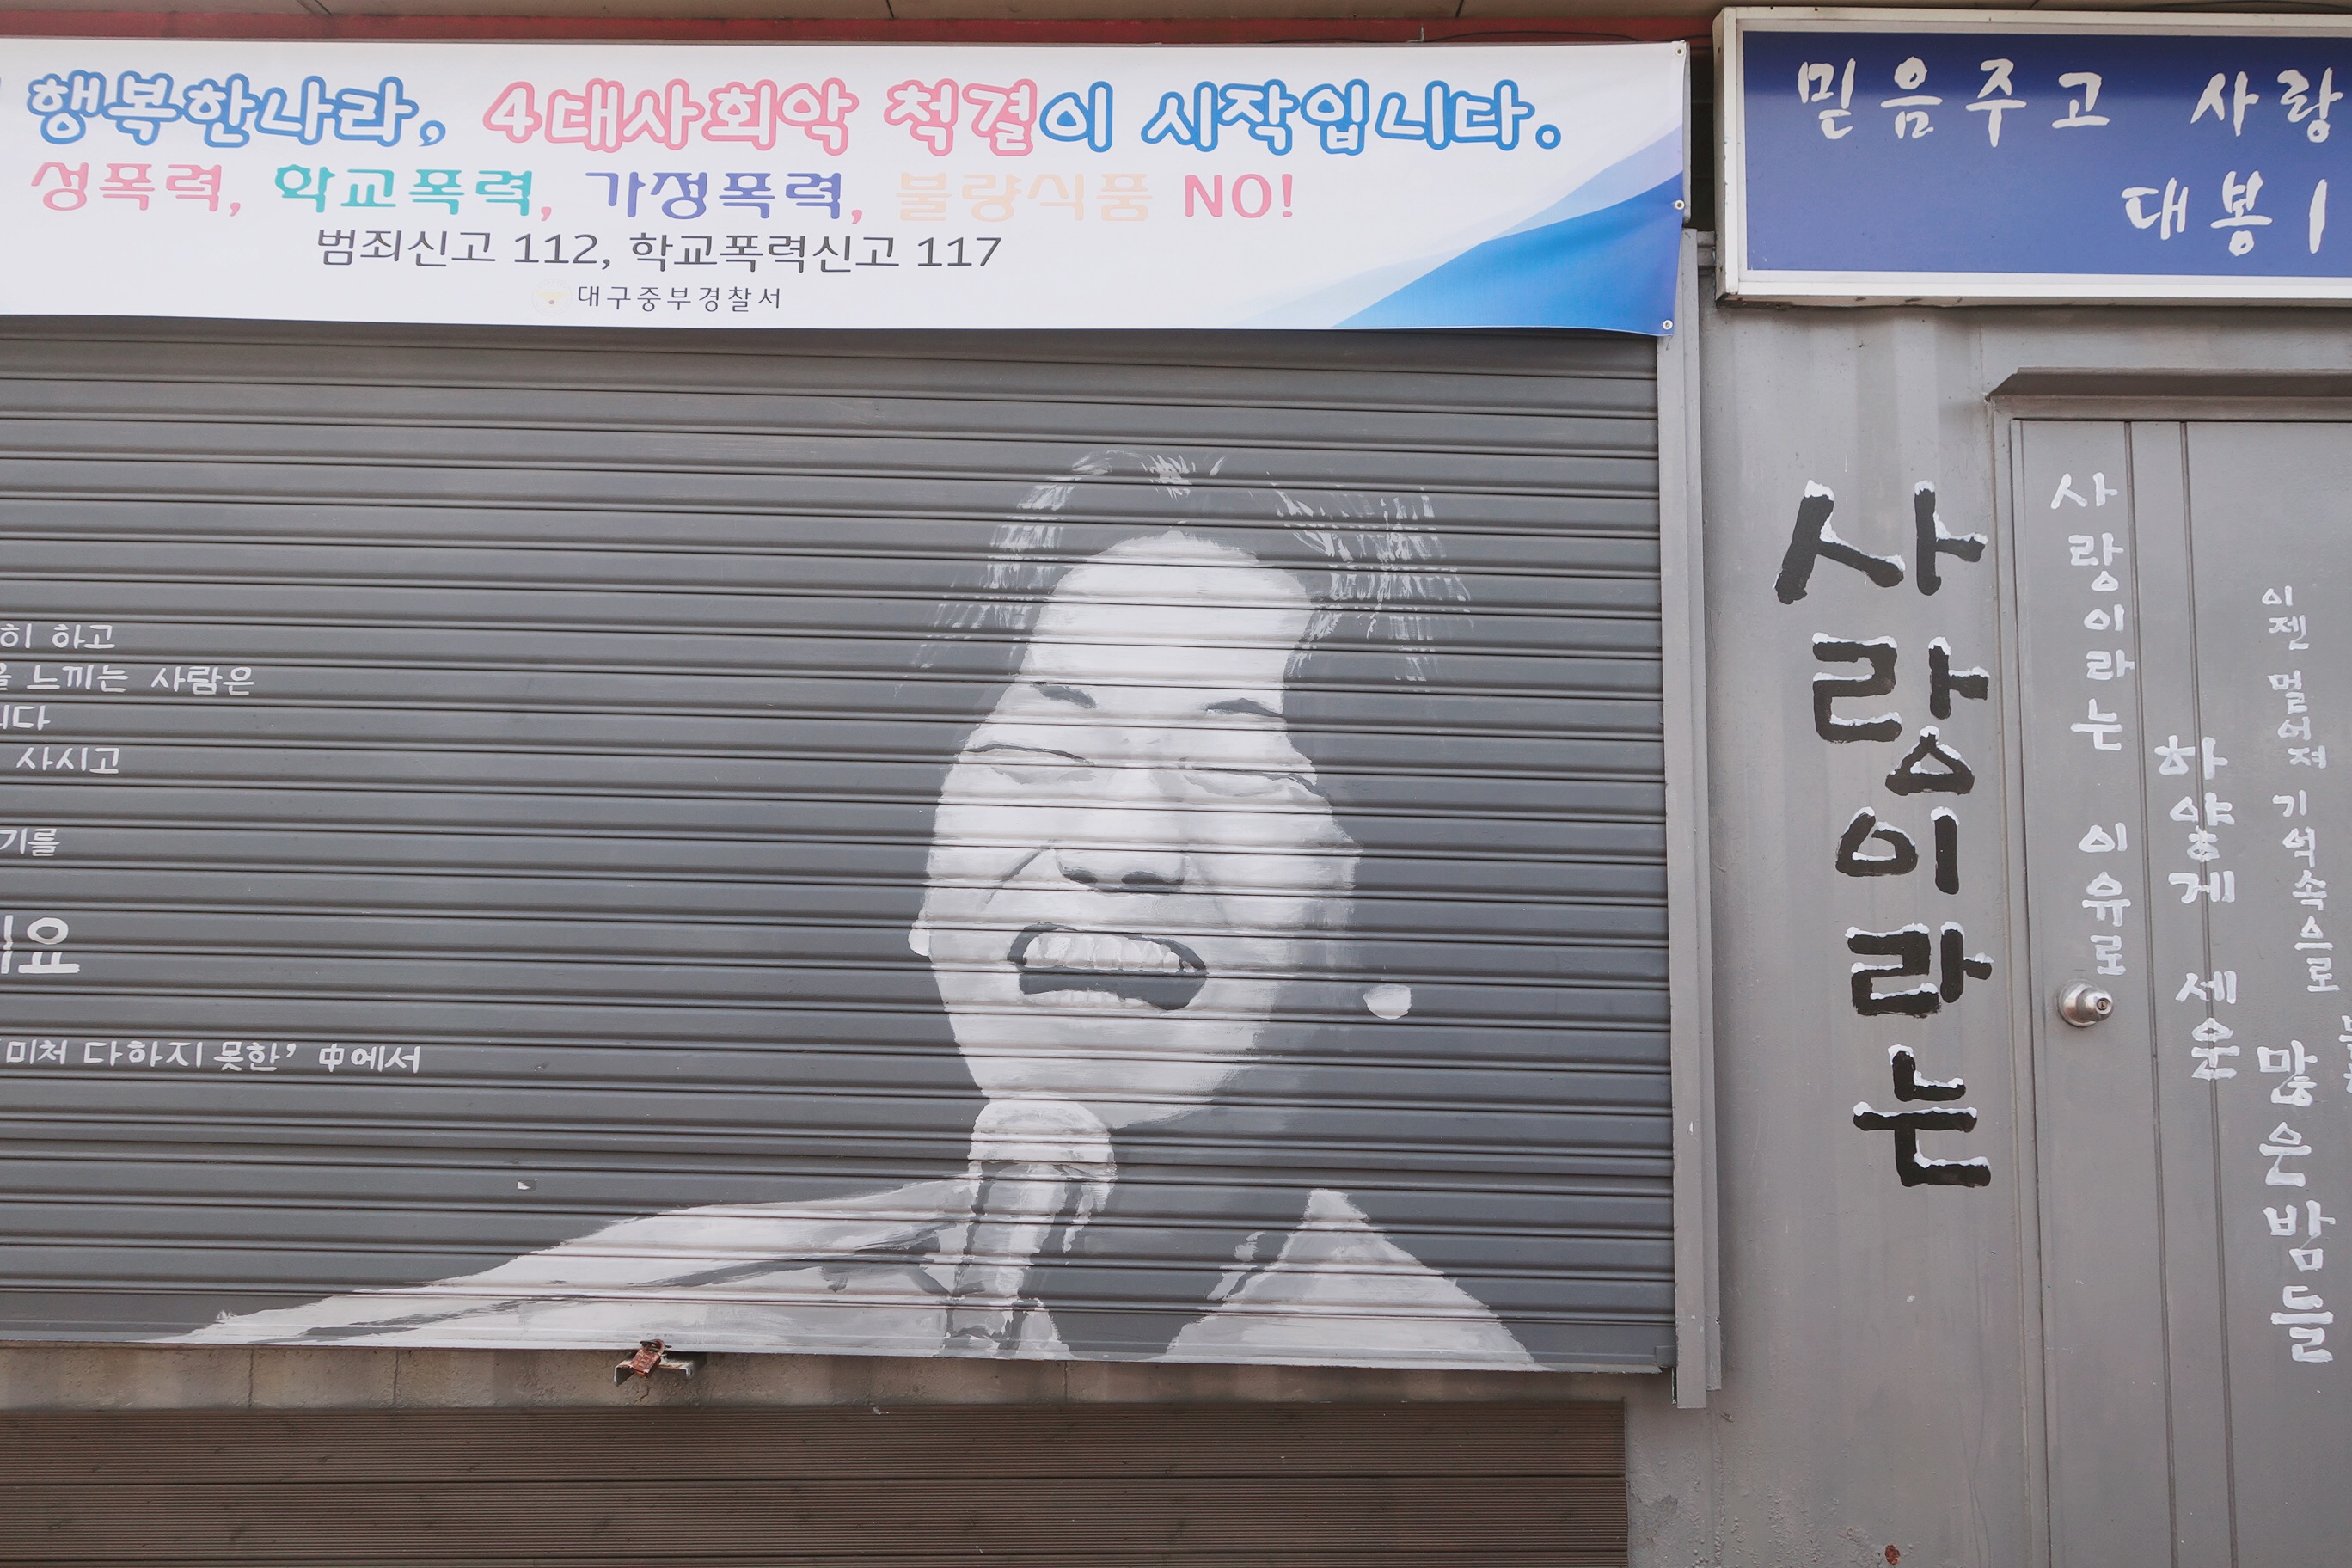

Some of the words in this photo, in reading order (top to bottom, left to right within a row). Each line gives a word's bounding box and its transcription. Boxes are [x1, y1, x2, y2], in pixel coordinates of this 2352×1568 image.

[28, 70, 446, 148] 행복한나라,
[483, 78, 859, 156] 4대사회악
[884, 78, 1113, 156] 척결이
[1141, 78, 1562, 156] 시작입니다.
[1798, 57, 2110, 147] 믿음주고
[32, 162, 240, 214] 성폭력,
[275, 165, 550, 220] 학교폭력,
[587, 172, 861, 224] 가정폭력,
[898, 174, 1150, 221] 불량식품
[1185, 174, 1292, 218] NO!
[318, 230, 495, 266] 범죄신고
[515, 234, 609, 270] 112,
[630, 233, 899, 273] 학교폭력신고
[918, 237, 1001, 266] 117
[579, 286, 779, 312] 대구중부경찰서
[52, 624, 115, 648] 하고
[2051, 473, 2135, 750] 사랑이라는
[2262, 585, 2309, 650] 이젠
[27, 665, 128, 692] 느끼는
[151, 666, 254, 695] 사람은
[2268, 670, 2326, 769] 멀어져
[16, 747, 119, 773] 사시고
[1774, 480, 1993, 1186] 사랑이라는
[2154, 735, 2235, 903] 하얗게
[2079, 823, 2131, 975] 이유로
[84, 1041, 203, 1067] 다하지
[2257, 1040, 2318, 1187] 많은
[2263, 1200, 2336, 1362] 밤들
